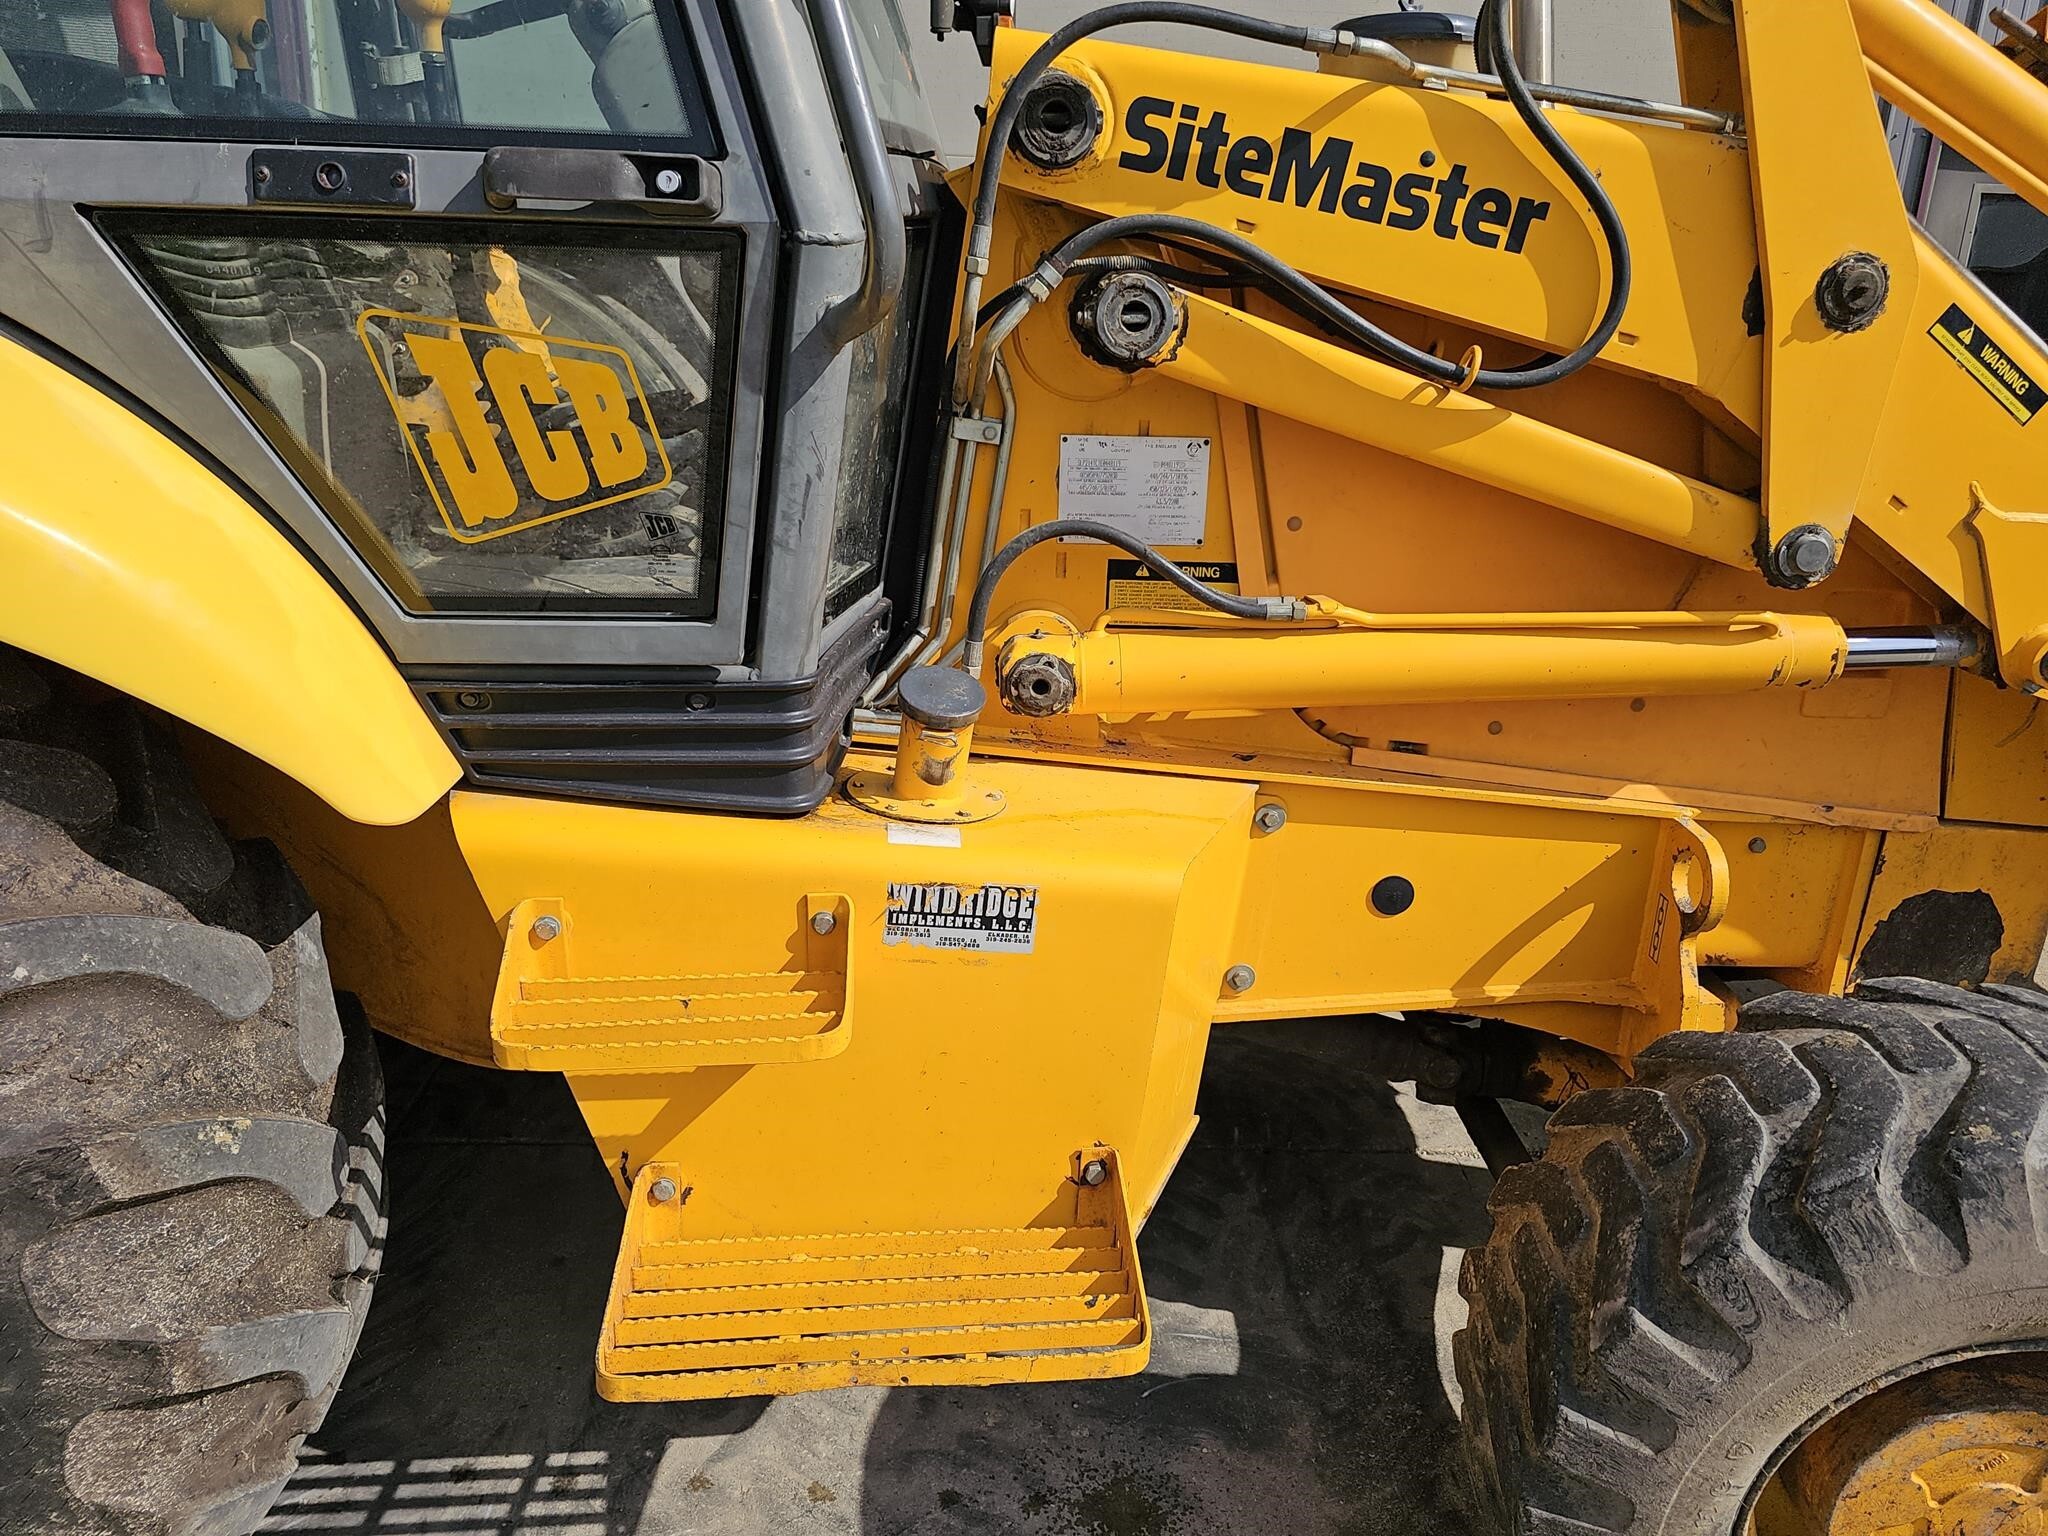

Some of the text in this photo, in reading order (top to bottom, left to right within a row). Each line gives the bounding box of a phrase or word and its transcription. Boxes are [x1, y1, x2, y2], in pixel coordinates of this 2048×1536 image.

[1118, 96, 1550, 254] SiteMaster
[1980, 343, 2030, 396] WARNING
[403, 332, 648, 528] JCB
[645, 514, 676, 539] JCB
[888, 883, 1034, 919] WINDRIDGE
[891, 912, 1031, 932] IMPLEMENTS, L.L.C.
